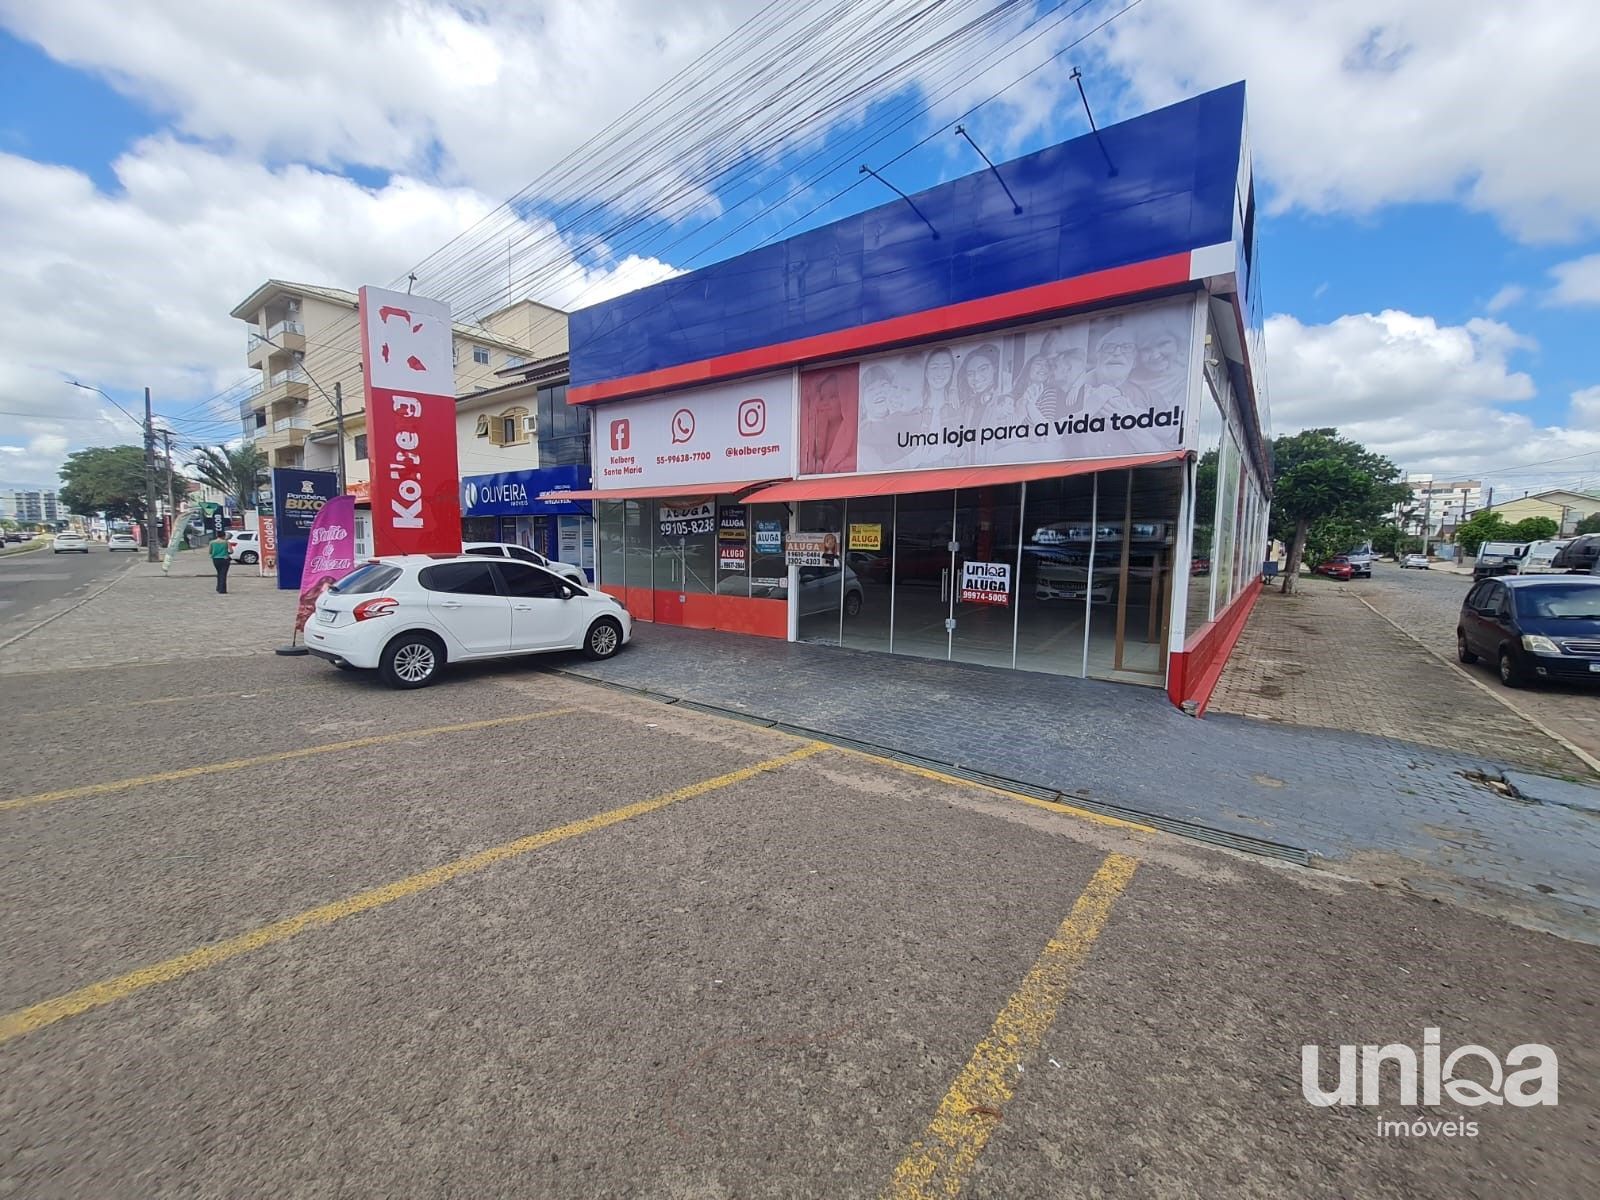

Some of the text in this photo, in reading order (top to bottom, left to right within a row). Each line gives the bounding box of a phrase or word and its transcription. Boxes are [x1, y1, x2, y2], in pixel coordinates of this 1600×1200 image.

[897, 405, 1180, 448] Uma loja para a vida toda!
[725, 444, 780, 458] @kolbergsm
[610, 456, 635, 465] Kolberg
[656, 452, 711, 465] 55-99638-7700
[603, 466, 643, 476] Santa Maria
[481, 484, 528, 504] OLIVEIRA
[666, 504, 711, 519] ALUGA
[660, 518, 714, 536] 99105-8238
[721, 519, 745, 527] ALUGA
[757, 533, 780, 542] ALUGA
[851, 535, 879, 543] ALUGA
[787, 542, 820, 551] ALUGA
[965, 579, 1006, 591] ALUGA
[963, 590, 1007, 602] 99974-5005
